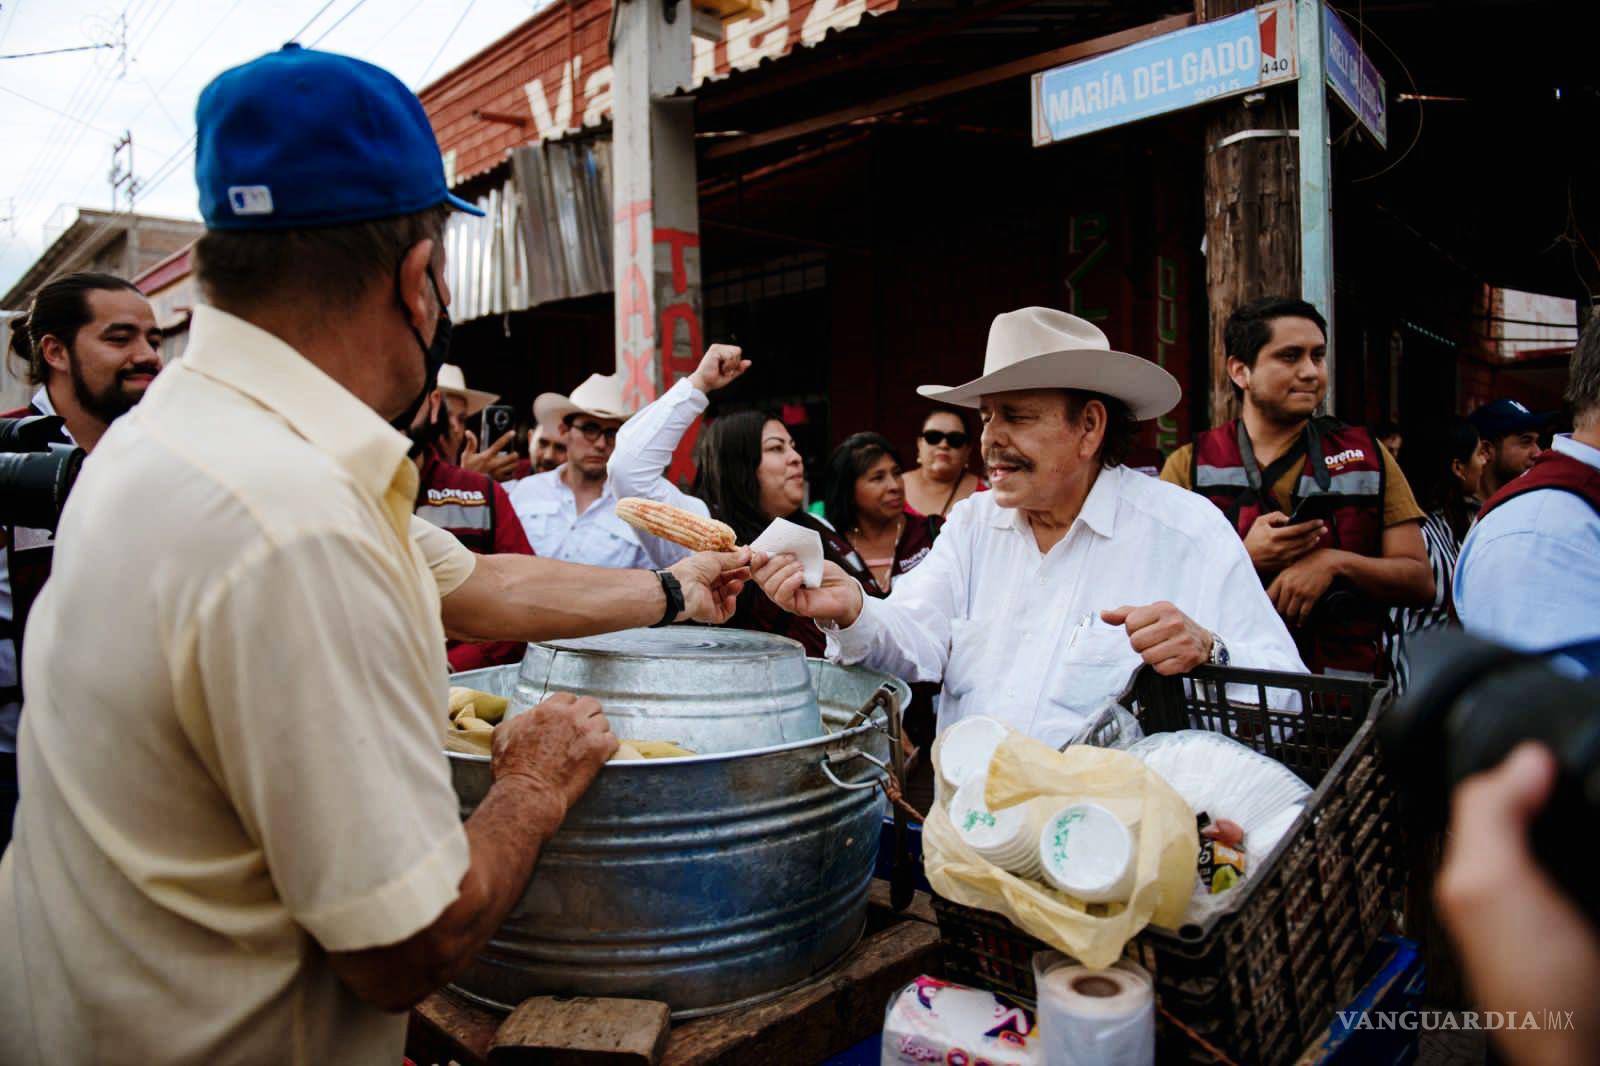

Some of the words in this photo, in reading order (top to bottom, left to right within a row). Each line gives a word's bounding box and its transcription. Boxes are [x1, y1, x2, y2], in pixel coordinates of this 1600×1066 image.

[1051, 68, 1127, 124] MARÍA
[1133, 35, 1254, 100] DELGADO
[614, 200, 657, 413] TAX
[1324, 449, 1364, 466] orena
